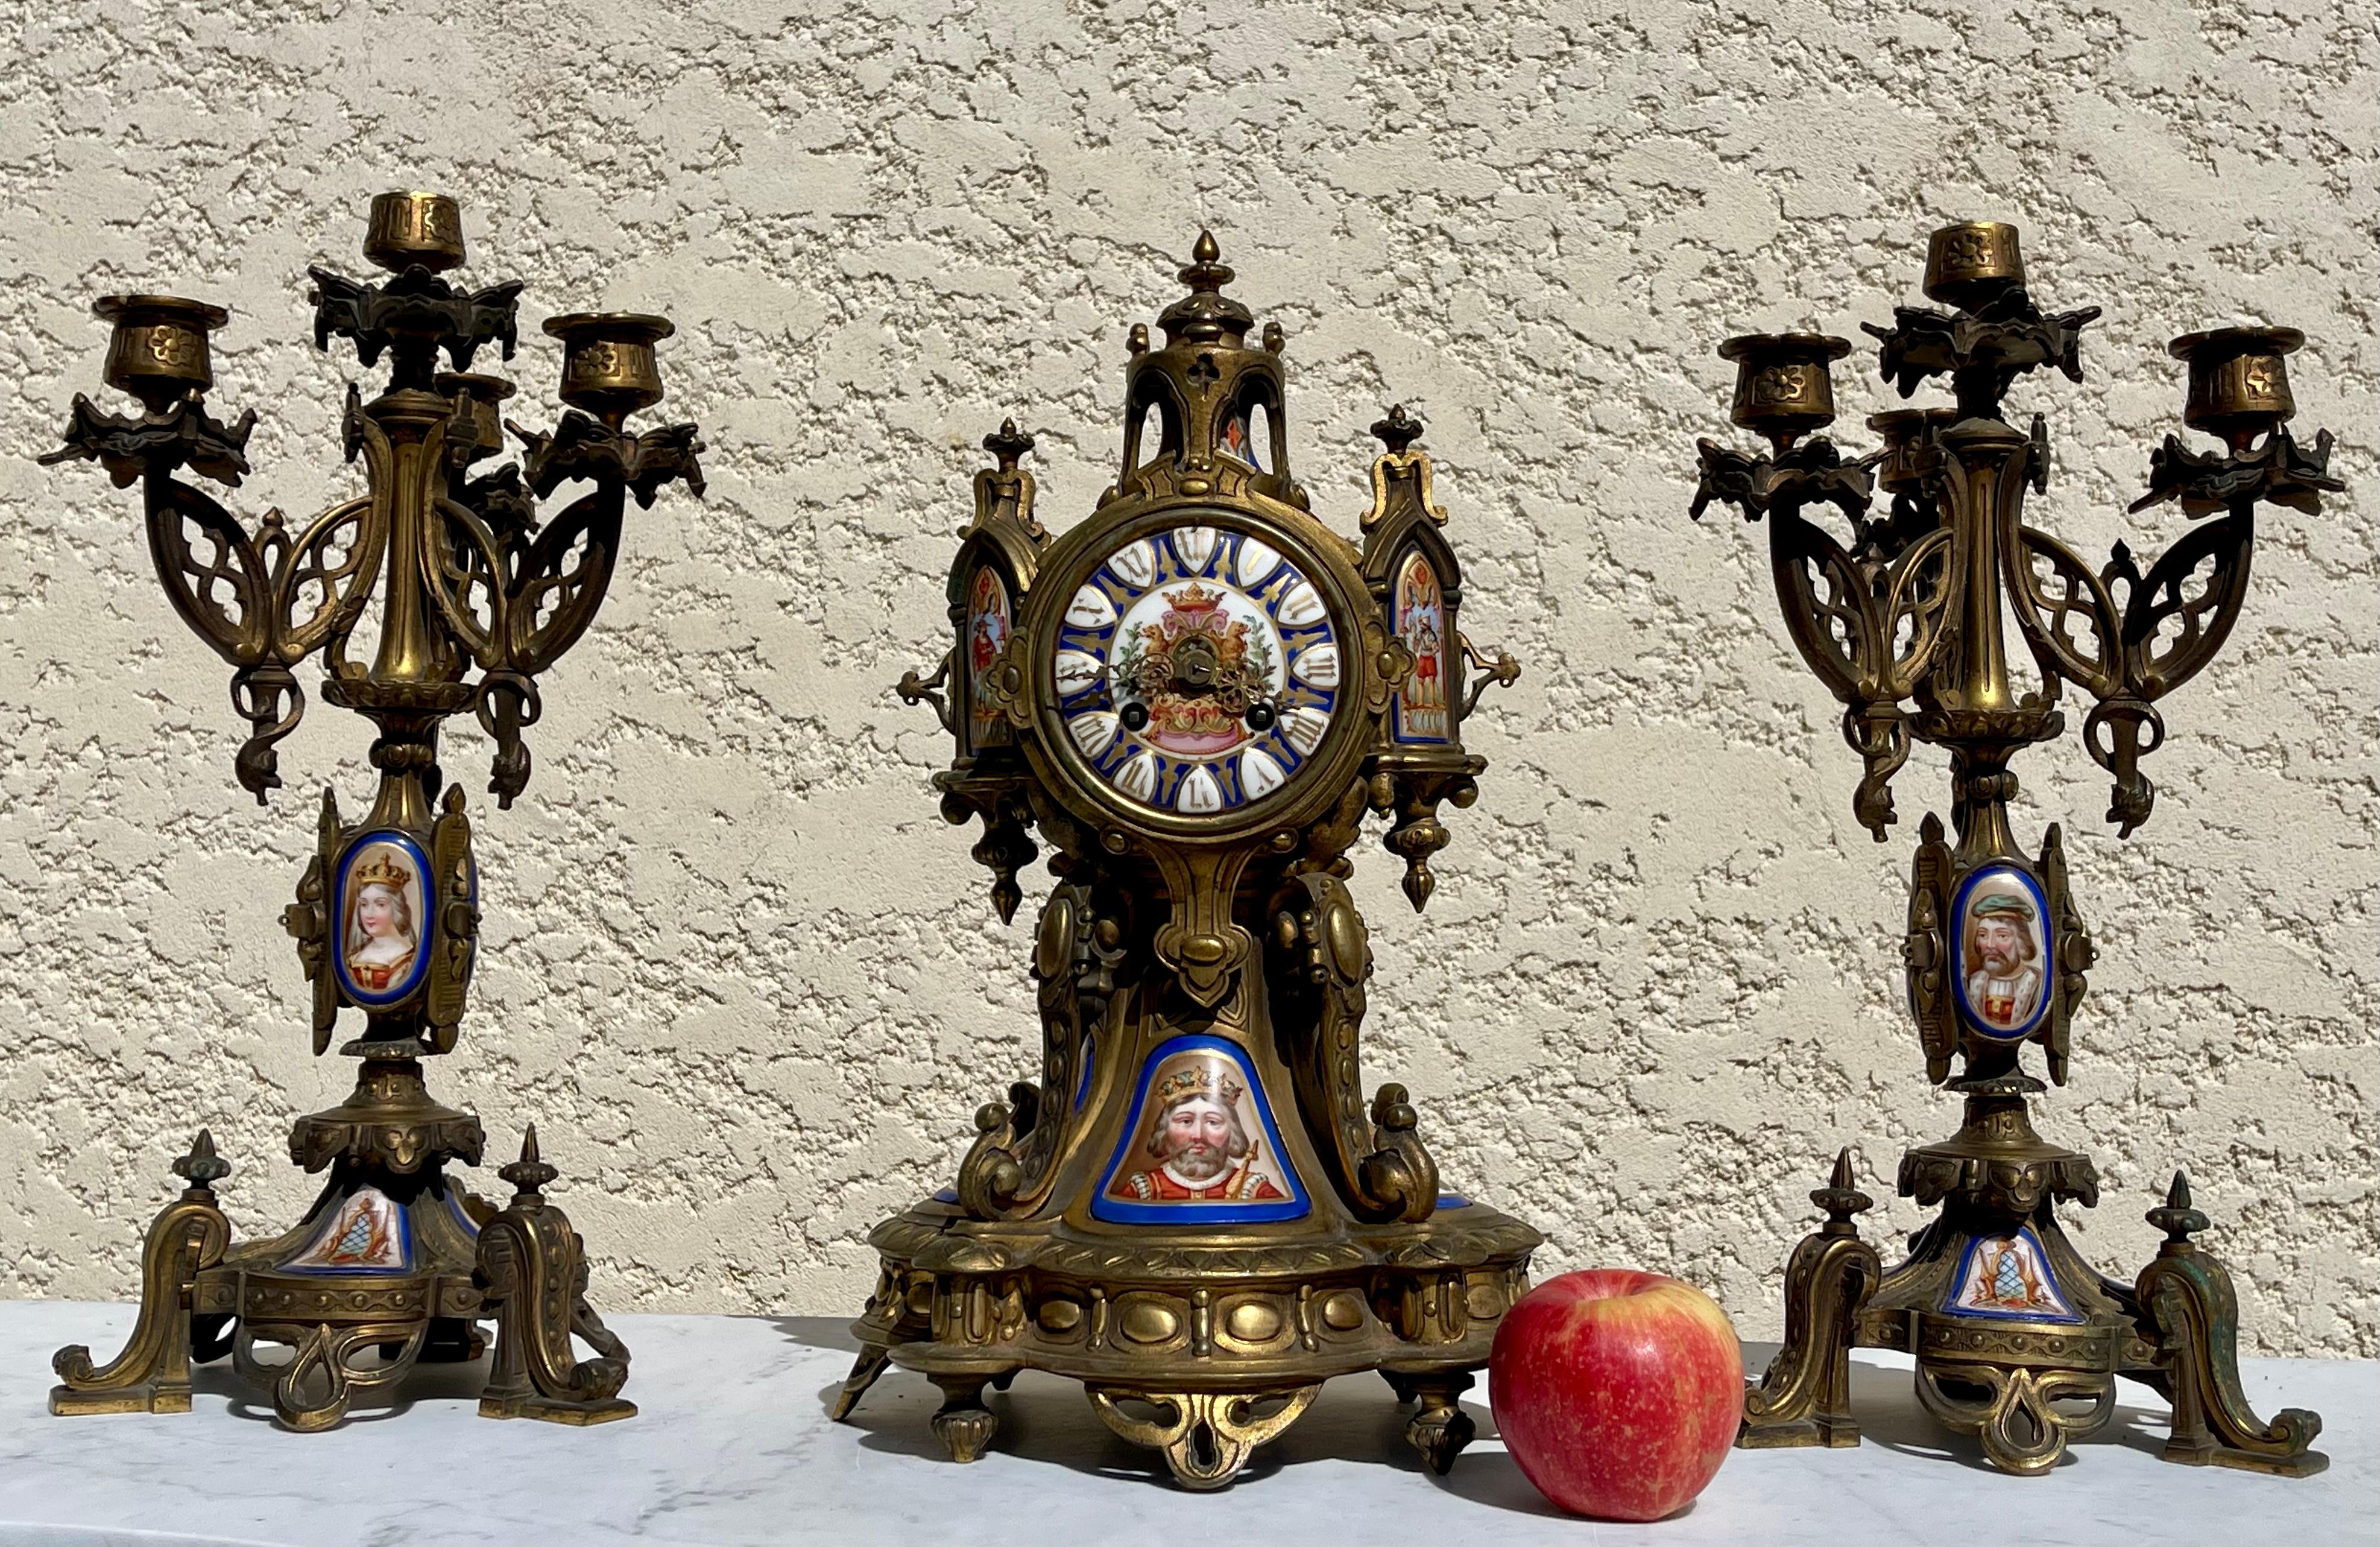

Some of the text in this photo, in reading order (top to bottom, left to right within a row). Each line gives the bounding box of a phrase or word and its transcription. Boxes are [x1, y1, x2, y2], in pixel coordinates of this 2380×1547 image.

[1115, 546, 1150, 583] XI
[1245, 548, 1265, 575] I
[1284, 592, 1318, 620] II
[1302, 653, 1336, 680] III
[1074, 716, 1110, 753] VIII
[1283, 713, 1325, 751] IIII
[1253, 760, 1275, 793] V
[1188, 777, 1214, 809] VI
